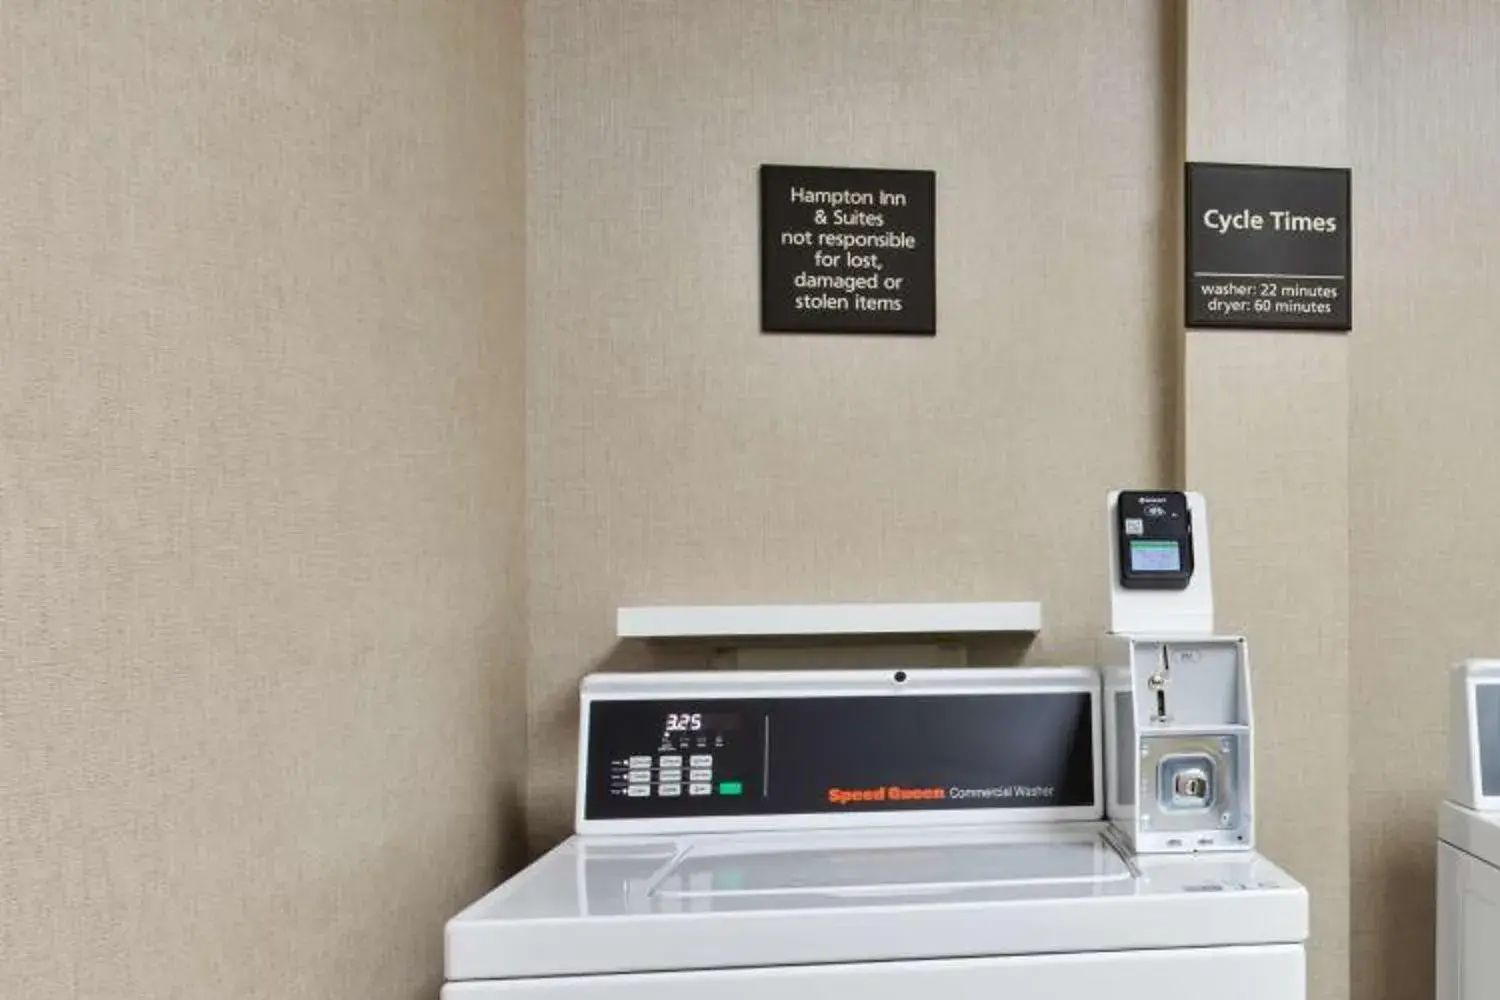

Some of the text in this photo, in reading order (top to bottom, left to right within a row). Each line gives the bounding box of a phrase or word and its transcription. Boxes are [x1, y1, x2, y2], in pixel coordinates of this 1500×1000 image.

[790, 186, 907, 207] Hampton Inn
[814, 209, 884, 227] & Suites
[1203, 209, 1337, 234] Cycle Times
[781, 231, 916, 250] not responsible
[814, 250, 883, 271] for lost,
[794, 272, 903, 292] damaged or
[1201, 282, 1338, 299] washer: 22 minutes
[794, 294, 903, 311] stolen items
[1207, 297, 1331, 314] dryer: 60 minutes
[828, 784, 1055, 804] Speed Queen Commercial Washer
